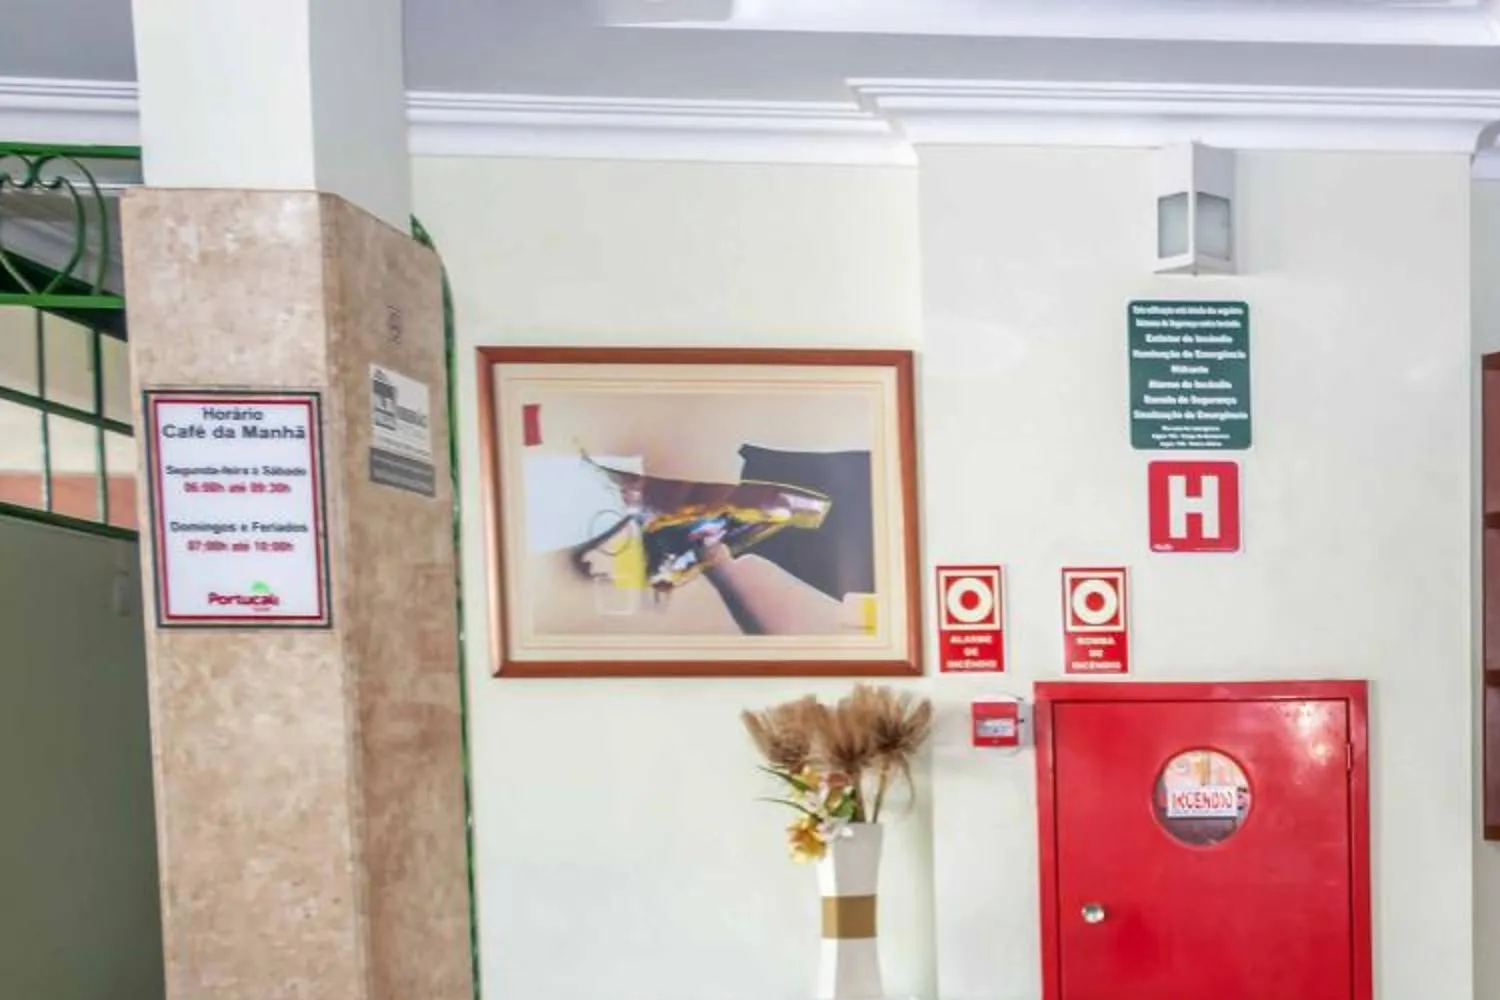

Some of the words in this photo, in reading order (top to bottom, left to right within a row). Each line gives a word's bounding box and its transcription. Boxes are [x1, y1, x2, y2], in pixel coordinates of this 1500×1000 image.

[202, 406, 265, 421] Horário
[162, 425, 206, 439] Café
[212, 425, 236, 439] da
[242, 425, 306, 440] Manhã
[1167, 475, 1220, 539] H
